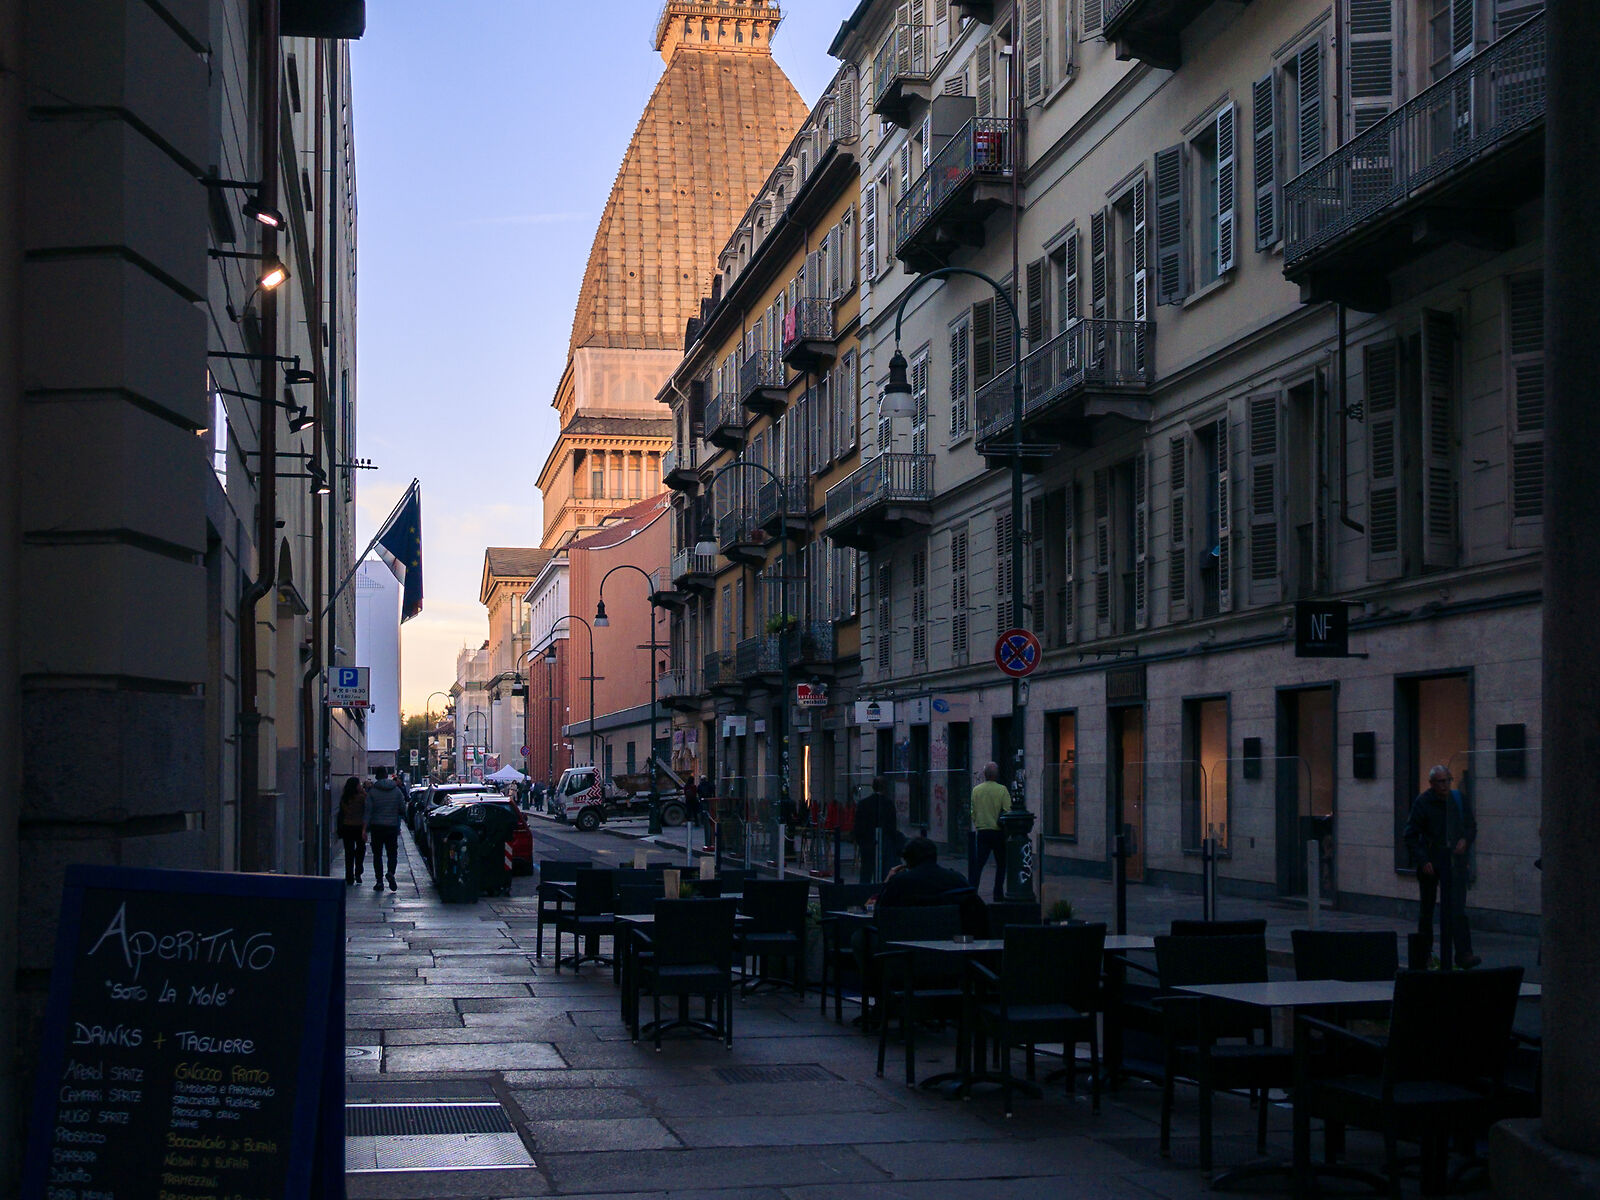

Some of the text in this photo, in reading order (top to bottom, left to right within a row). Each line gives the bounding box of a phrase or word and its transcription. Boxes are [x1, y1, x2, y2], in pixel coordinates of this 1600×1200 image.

[1312, 613, 1334, 640] NF
[344, 670, 354, 685] P
[158, 980, 177, 1003] LA
[72, 1022, 143, 1048] DRINKS
